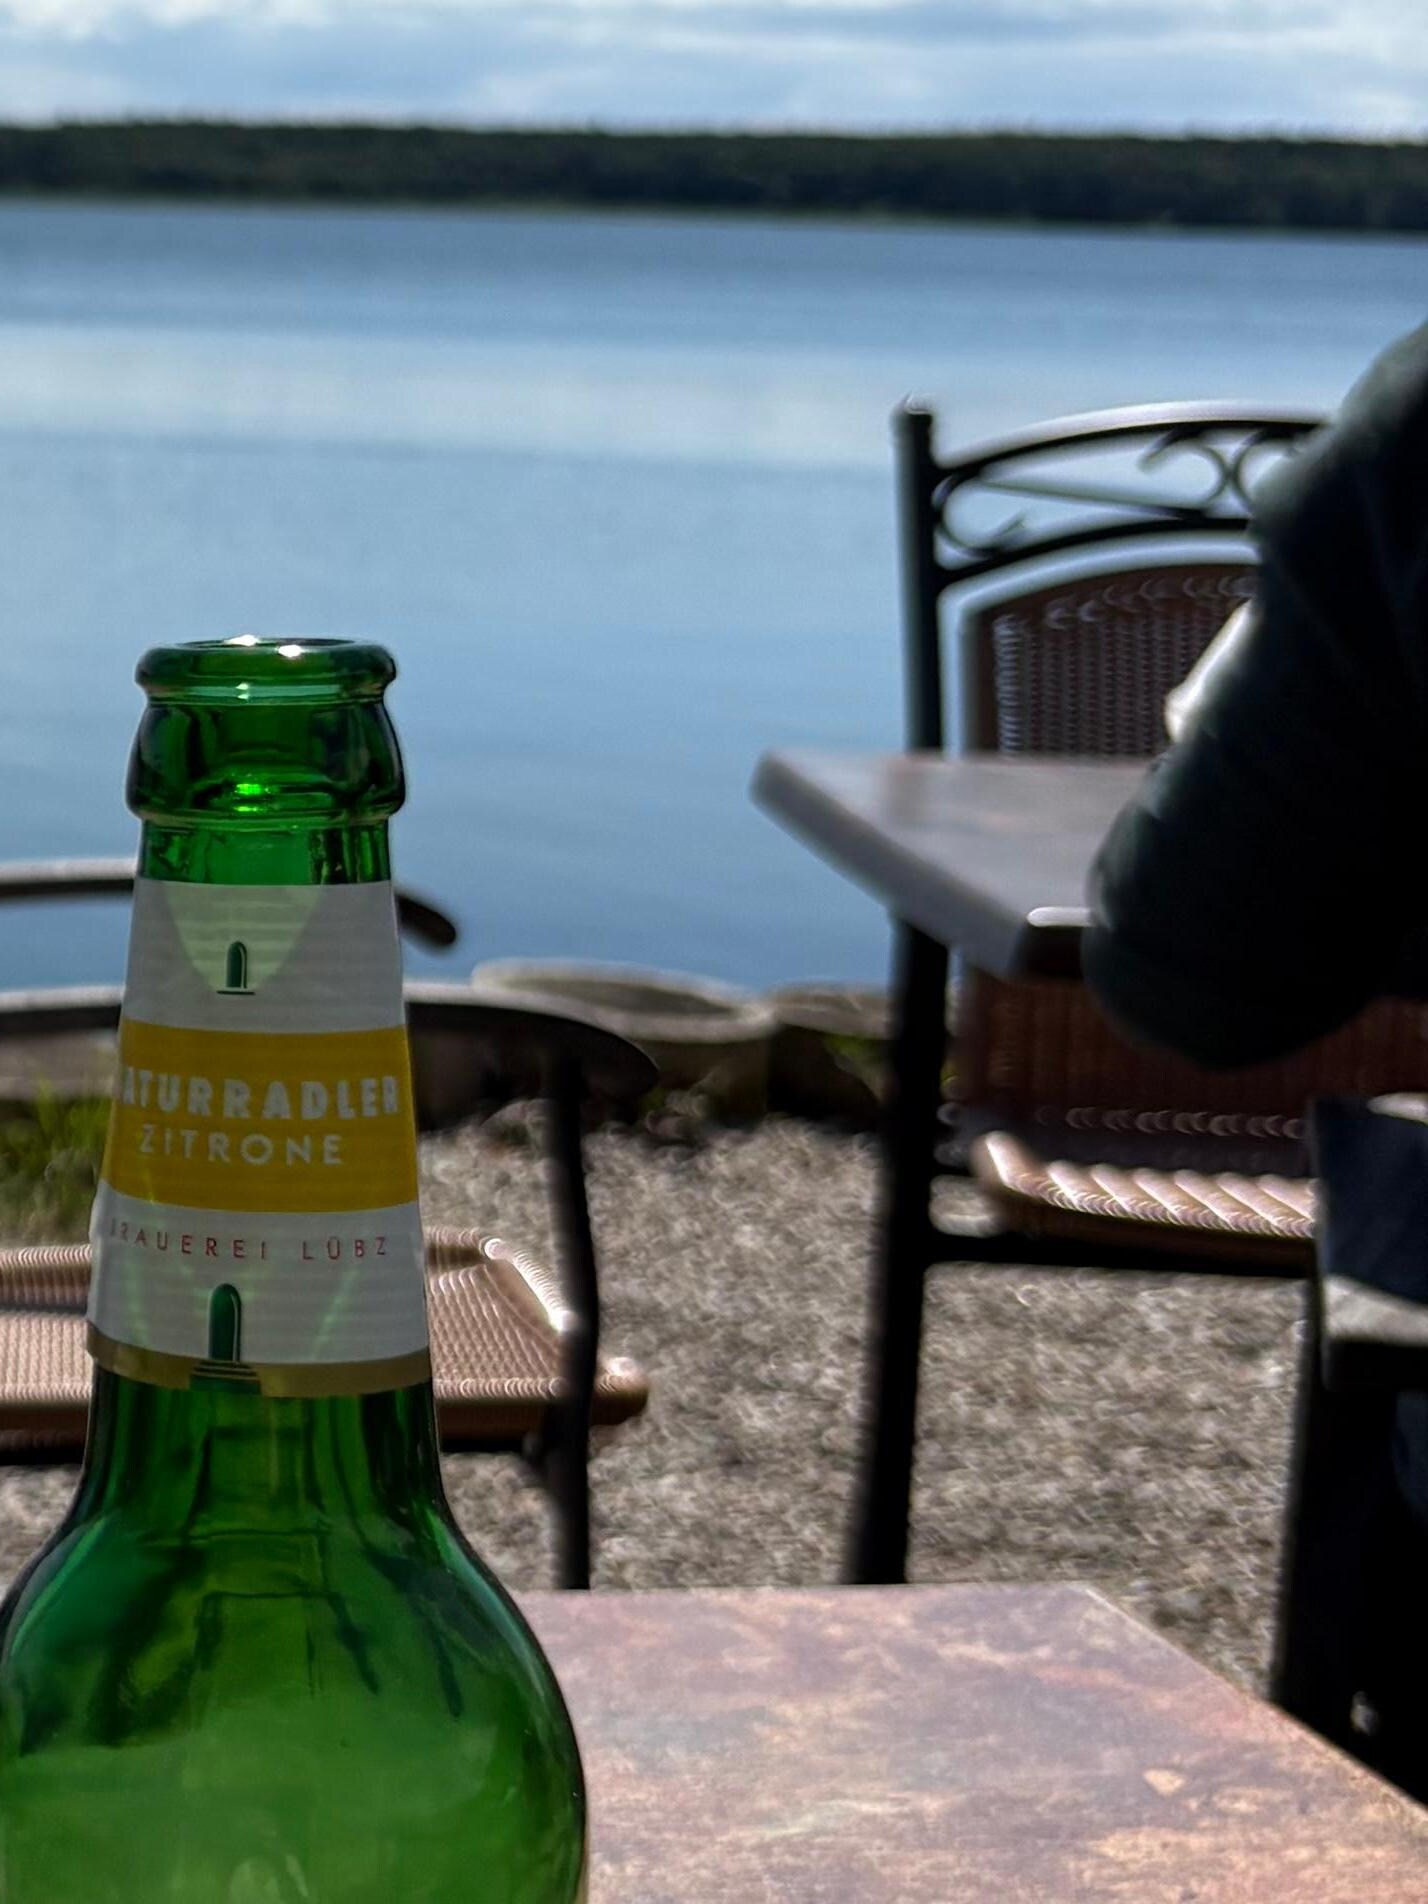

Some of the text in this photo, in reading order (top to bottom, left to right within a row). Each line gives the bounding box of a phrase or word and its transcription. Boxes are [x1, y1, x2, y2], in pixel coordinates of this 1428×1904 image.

[119, 1066, 399, 1120] ATURRADLER
[139, 1124, 344, 1166] ZITRONE
[302, 1236, 389, 1261] LÜBZ
